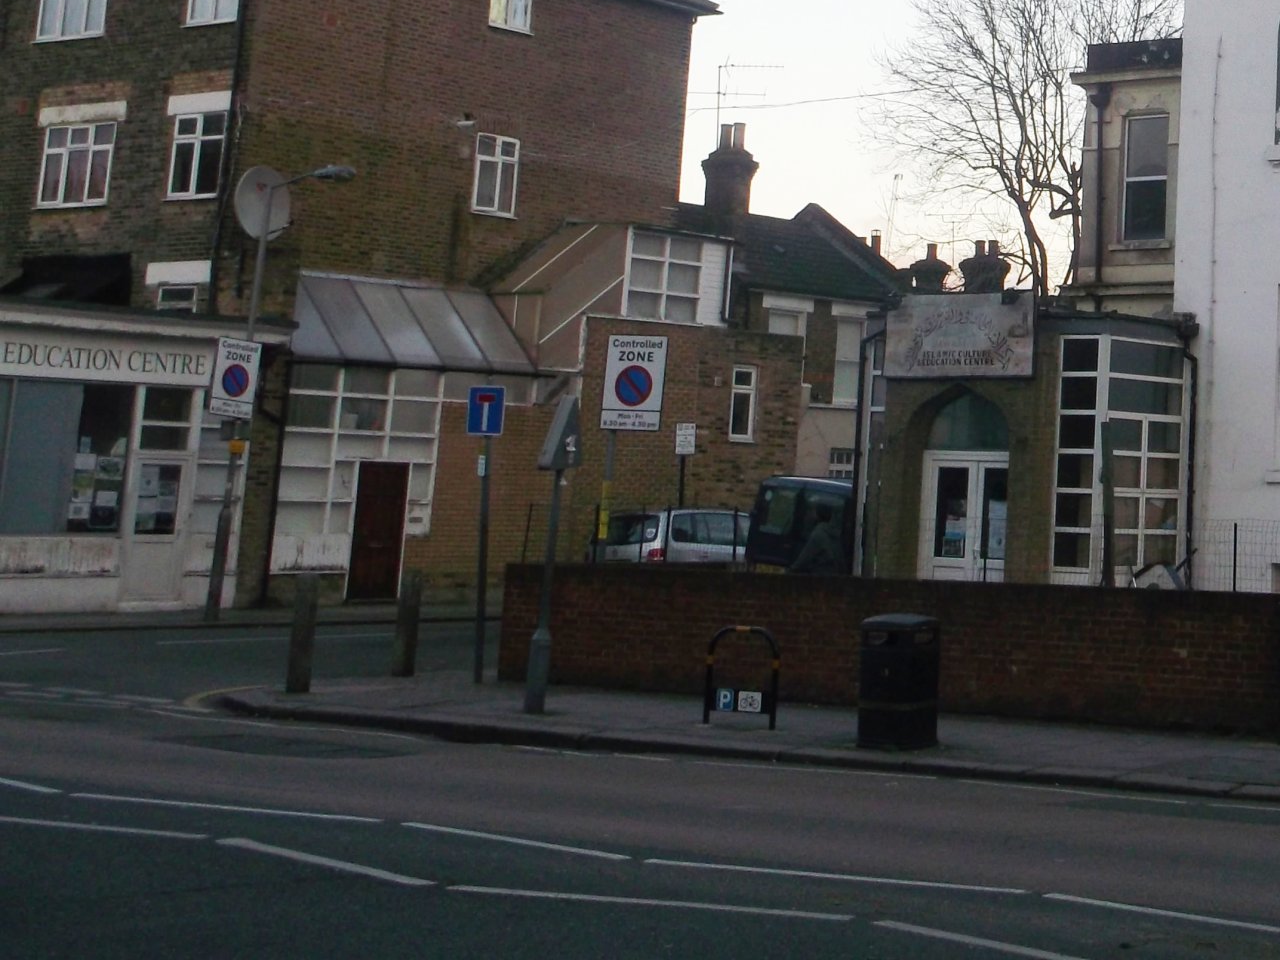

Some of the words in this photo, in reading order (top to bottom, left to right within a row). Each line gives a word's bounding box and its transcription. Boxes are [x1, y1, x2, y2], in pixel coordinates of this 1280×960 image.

[613, 339, 663, 349] Controlled
[3, 342, 122, 371] EDUCATION
[128, 350, 207, 376] CENTRE
[226, 350, 252, 363] ZONE
[618, 351, 654, 362] ZONE
[922, 350, 956, 359] ISLAMIC
[958, 349, 992, 358] CULTURE
[964, 358, 995, 366] CENTRE
[720, 691, 730, 709] P
